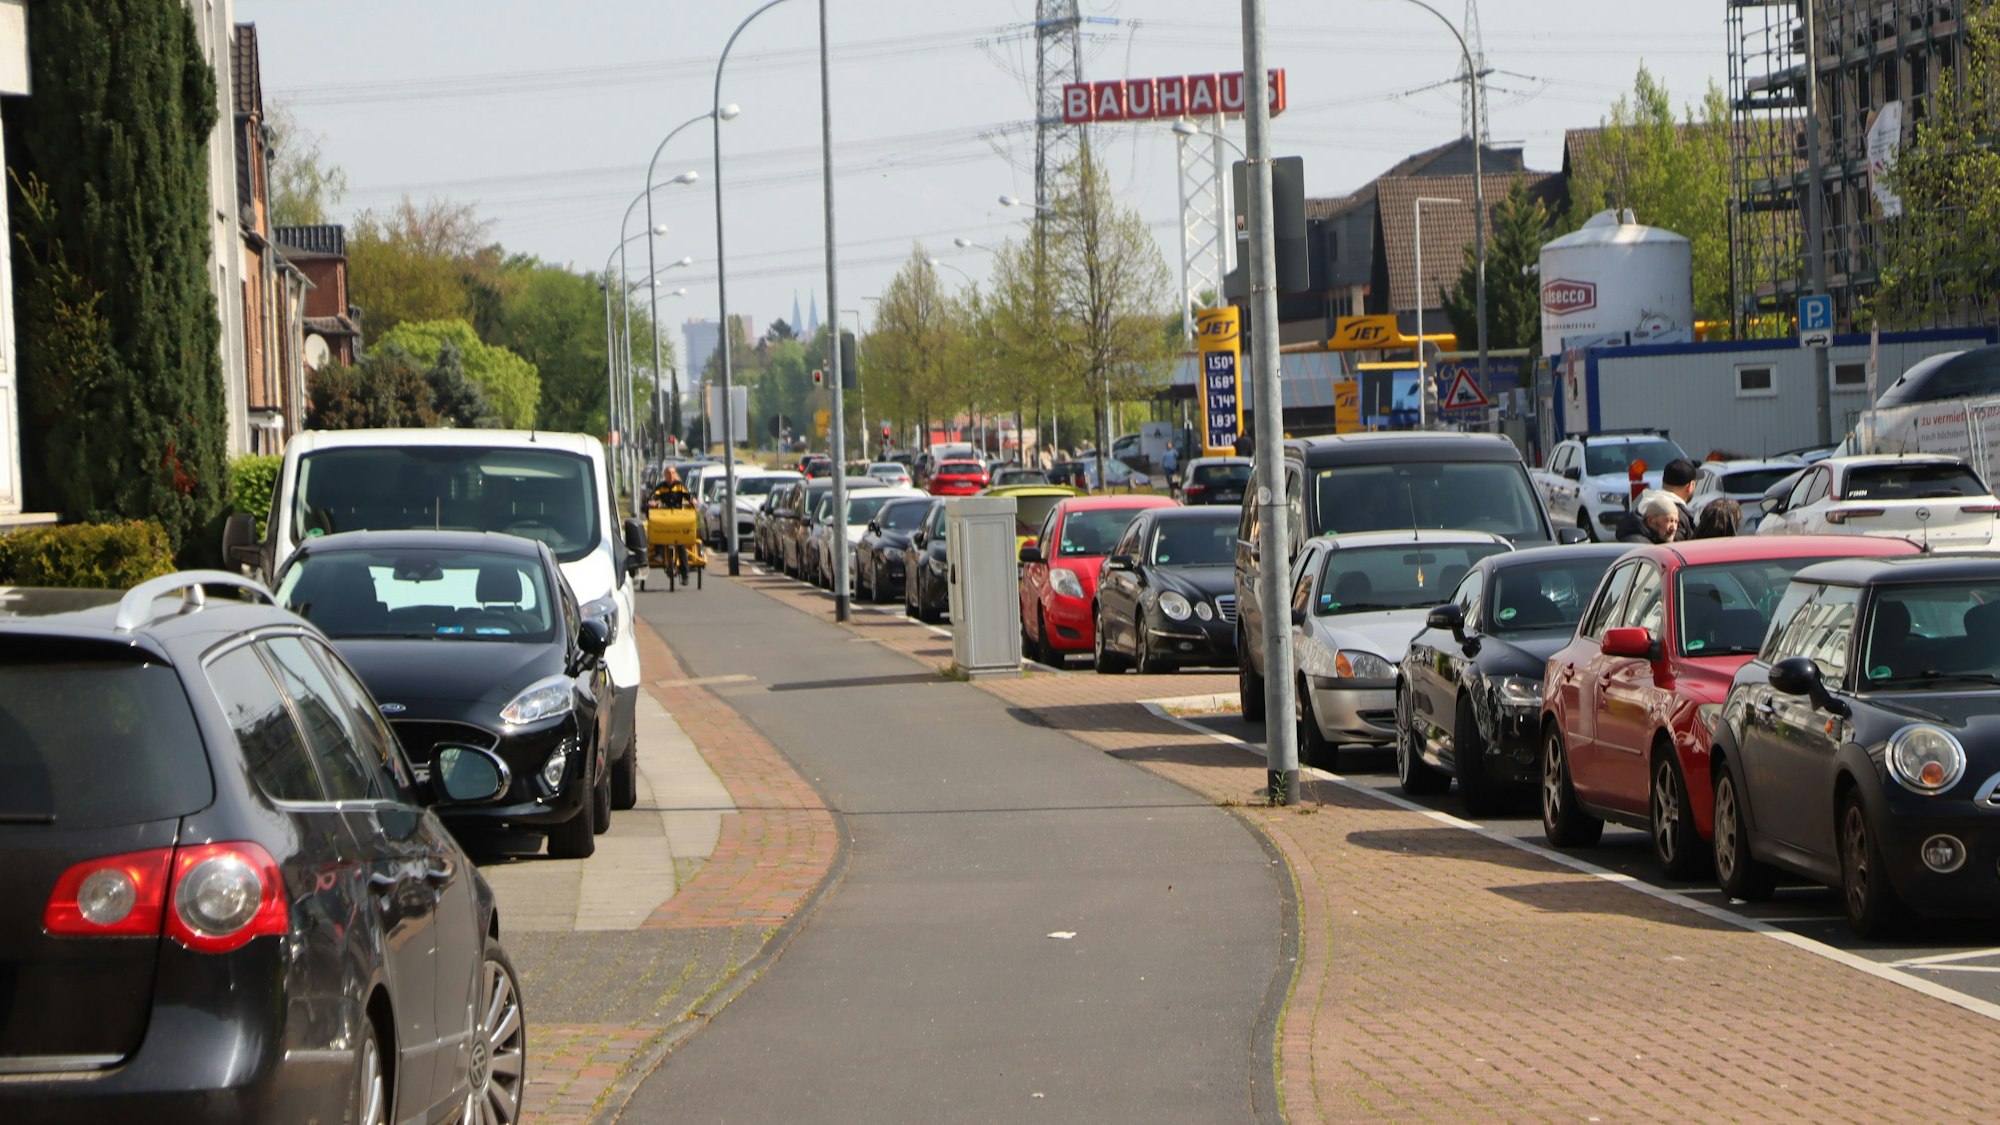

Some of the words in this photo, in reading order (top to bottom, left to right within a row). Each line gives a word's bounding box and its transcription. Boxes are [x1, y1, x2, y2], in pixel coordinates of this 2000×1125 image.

[1807, 301, 1824, 328] P
[1201, 321, 1235, 336] JET
[1350, 326, 1385, 341] JET
[1921, 416, 1932, 426] zu
